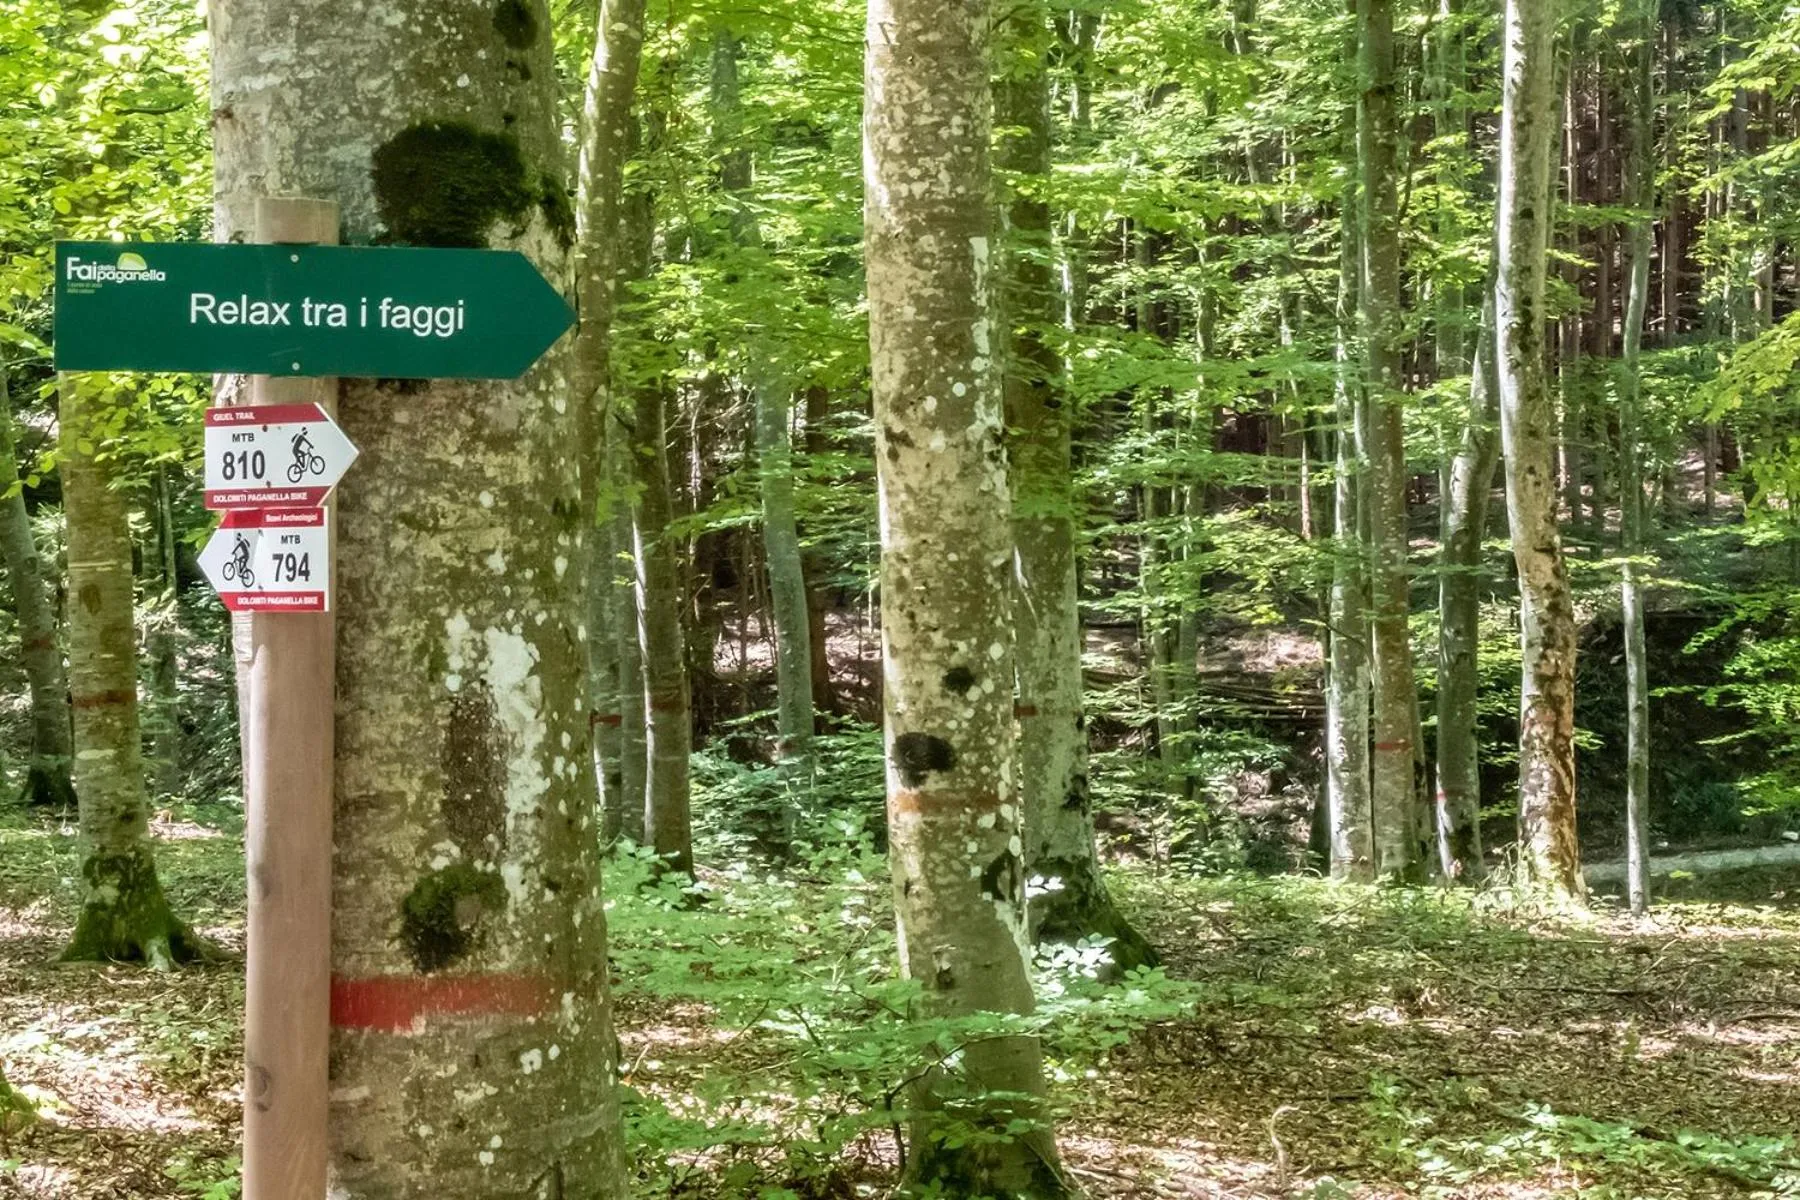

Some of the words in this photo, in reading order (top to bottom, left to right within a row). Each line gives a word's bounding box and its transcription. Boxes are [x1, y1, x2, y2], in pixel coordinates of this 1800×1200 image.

[67, 257, 97, 280] Fai
[97, 269, 166, 284] paganella
[190, 293, 291, 326] Relax
[302, 297, 347, 328] tra
[361, 297, 367, 328] i
[379, 297, 464, 337] faggi
[235, 412, 255, 420] TRAIL
[232, 433, 254, 442] MTB
[222, 450, 265, 480] 810
[213, 495, 247, 503] DOLOMITI
[247, 493, 290, 502] PAGANELLA
[290, 492, 308, 500] BIKE
[281, 535, 301, 544] MTB
[272, 552, 310, 582] 794
[237, 597, 267, 605] DOLOMITI
[267, 597, 303, 605] PAGANELLA
[303, 596, 318, 604] BIKE
